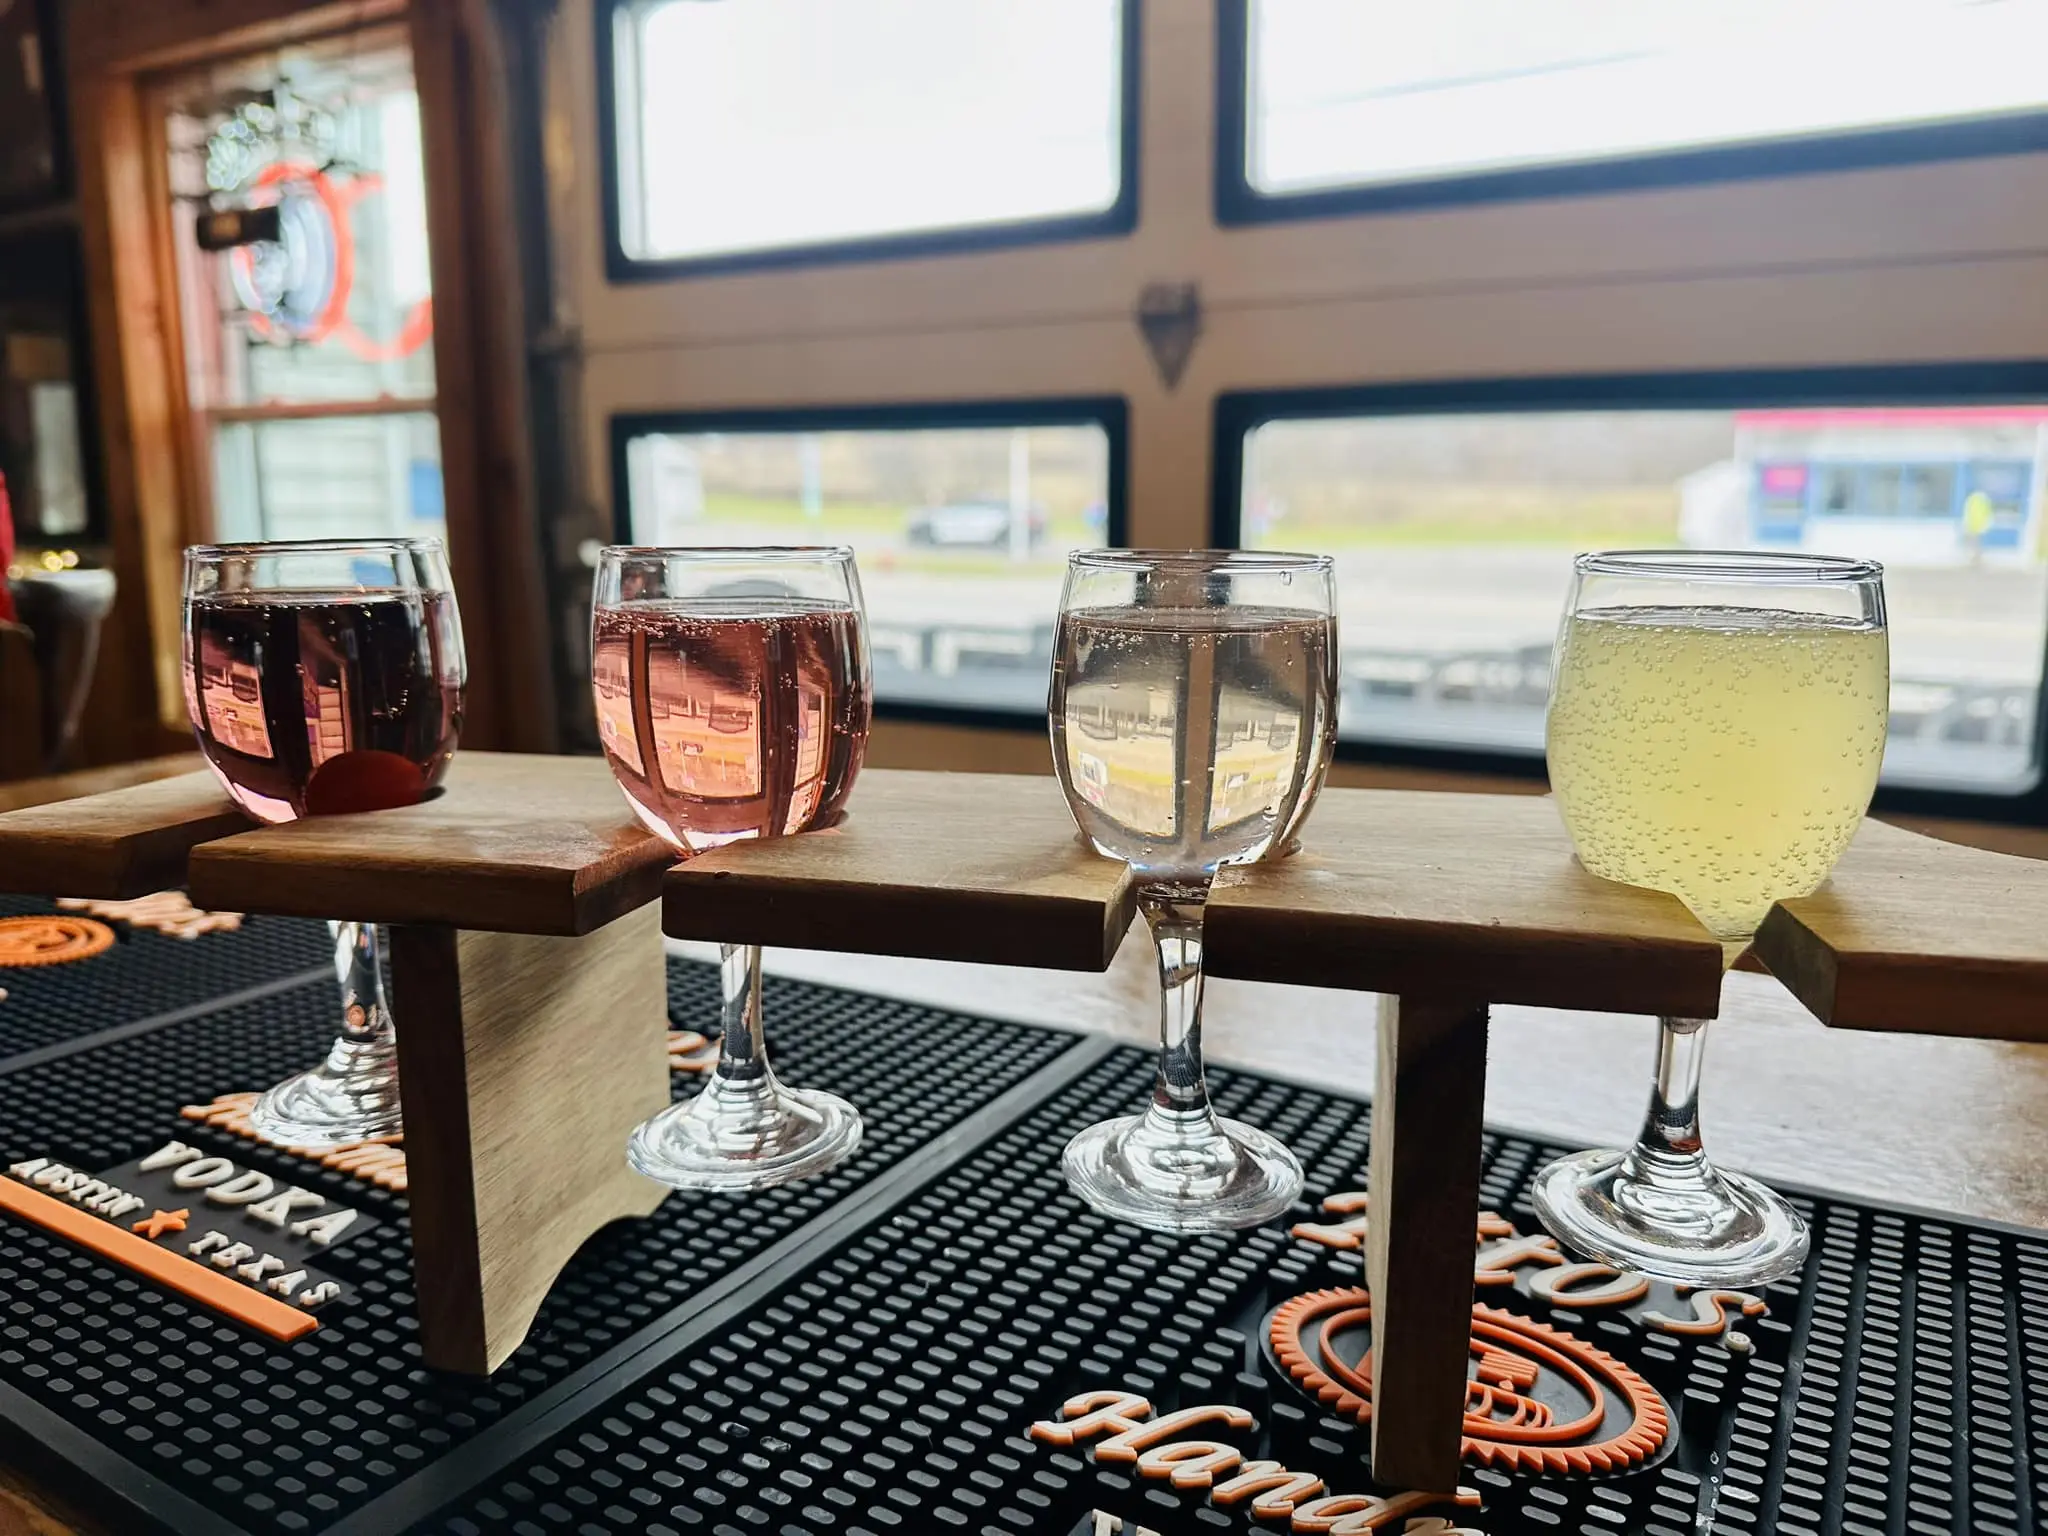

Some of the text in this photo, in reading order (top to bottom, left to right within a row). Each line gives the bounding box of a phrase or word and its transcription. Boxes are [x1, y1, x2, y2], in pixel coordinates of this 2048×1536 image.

[9, 1157, 341, 1306] AUSTIN TEXAS
[139, 1140, 359, 1245] VODKA
